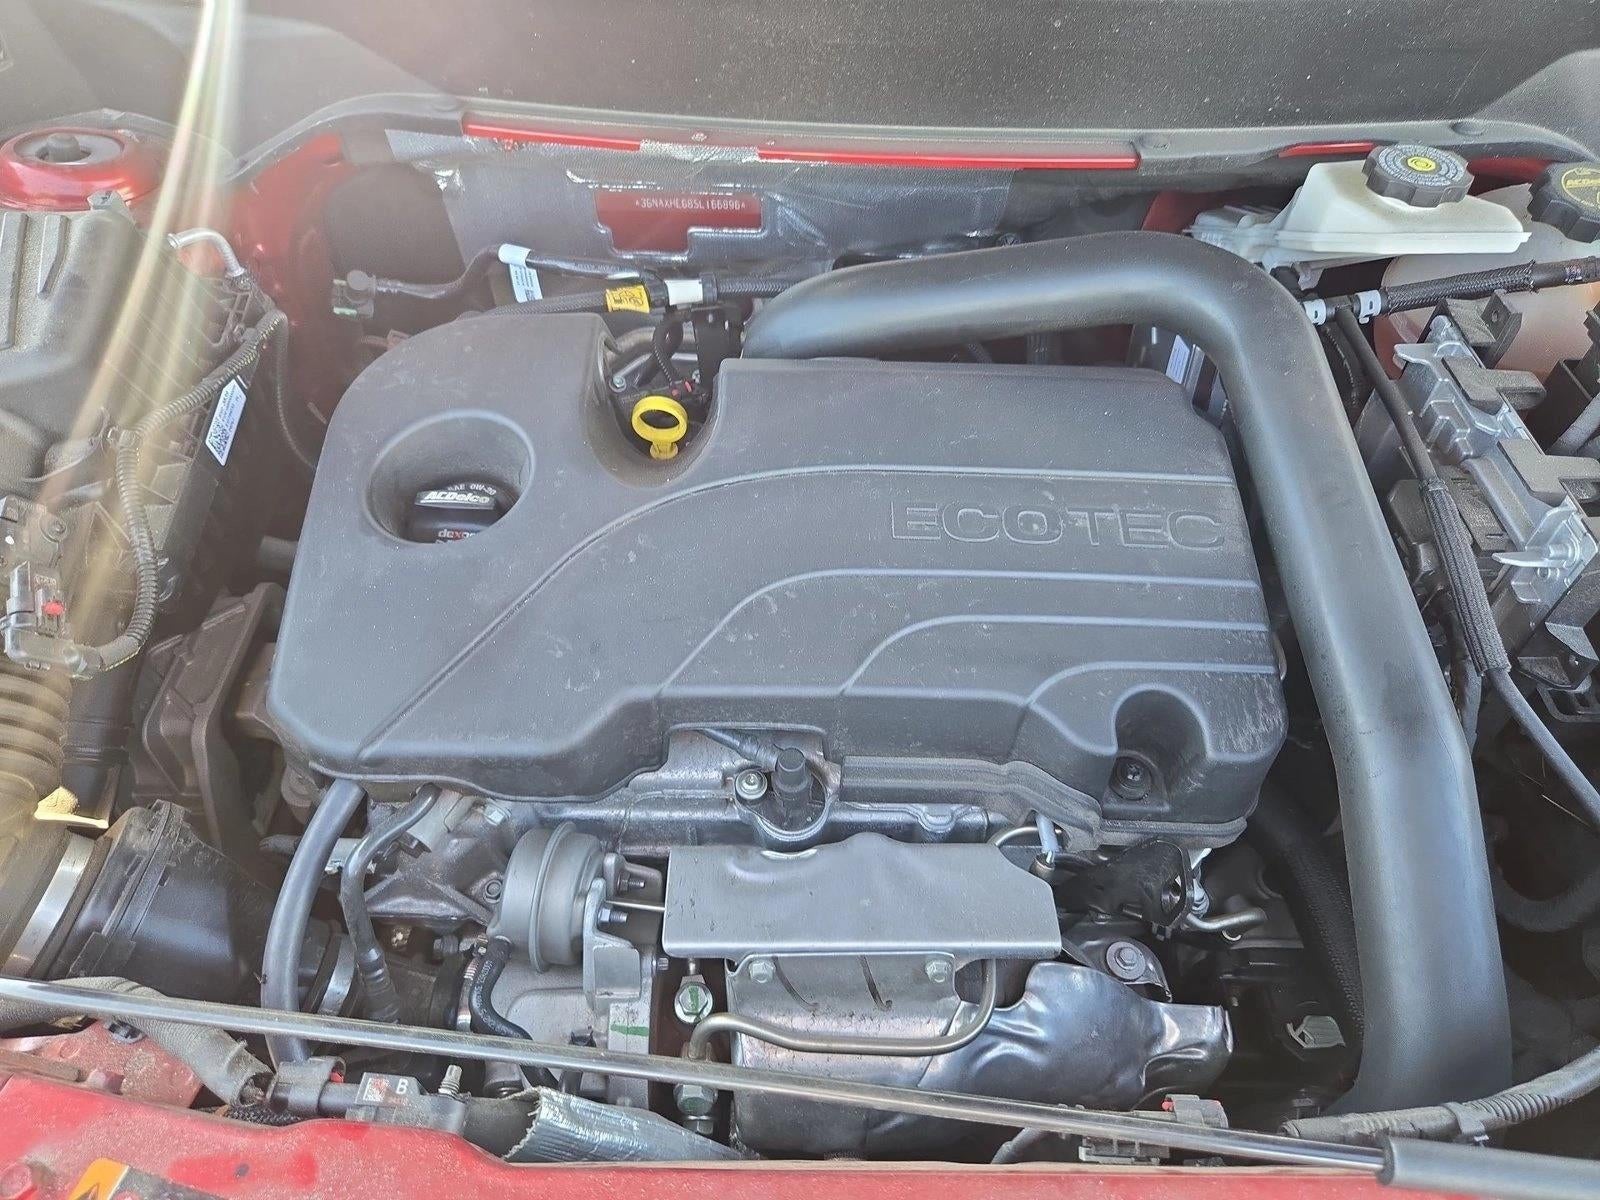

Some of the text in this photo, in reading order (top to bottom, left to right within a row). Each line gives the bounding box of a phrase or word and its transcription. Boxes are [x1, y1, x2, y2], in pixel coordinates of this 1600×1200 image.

[424, 491, 490, 504] ACDelco
[890, 499, 1223, 551] ECOTEC
[396, 1078, 409, 1095] B
